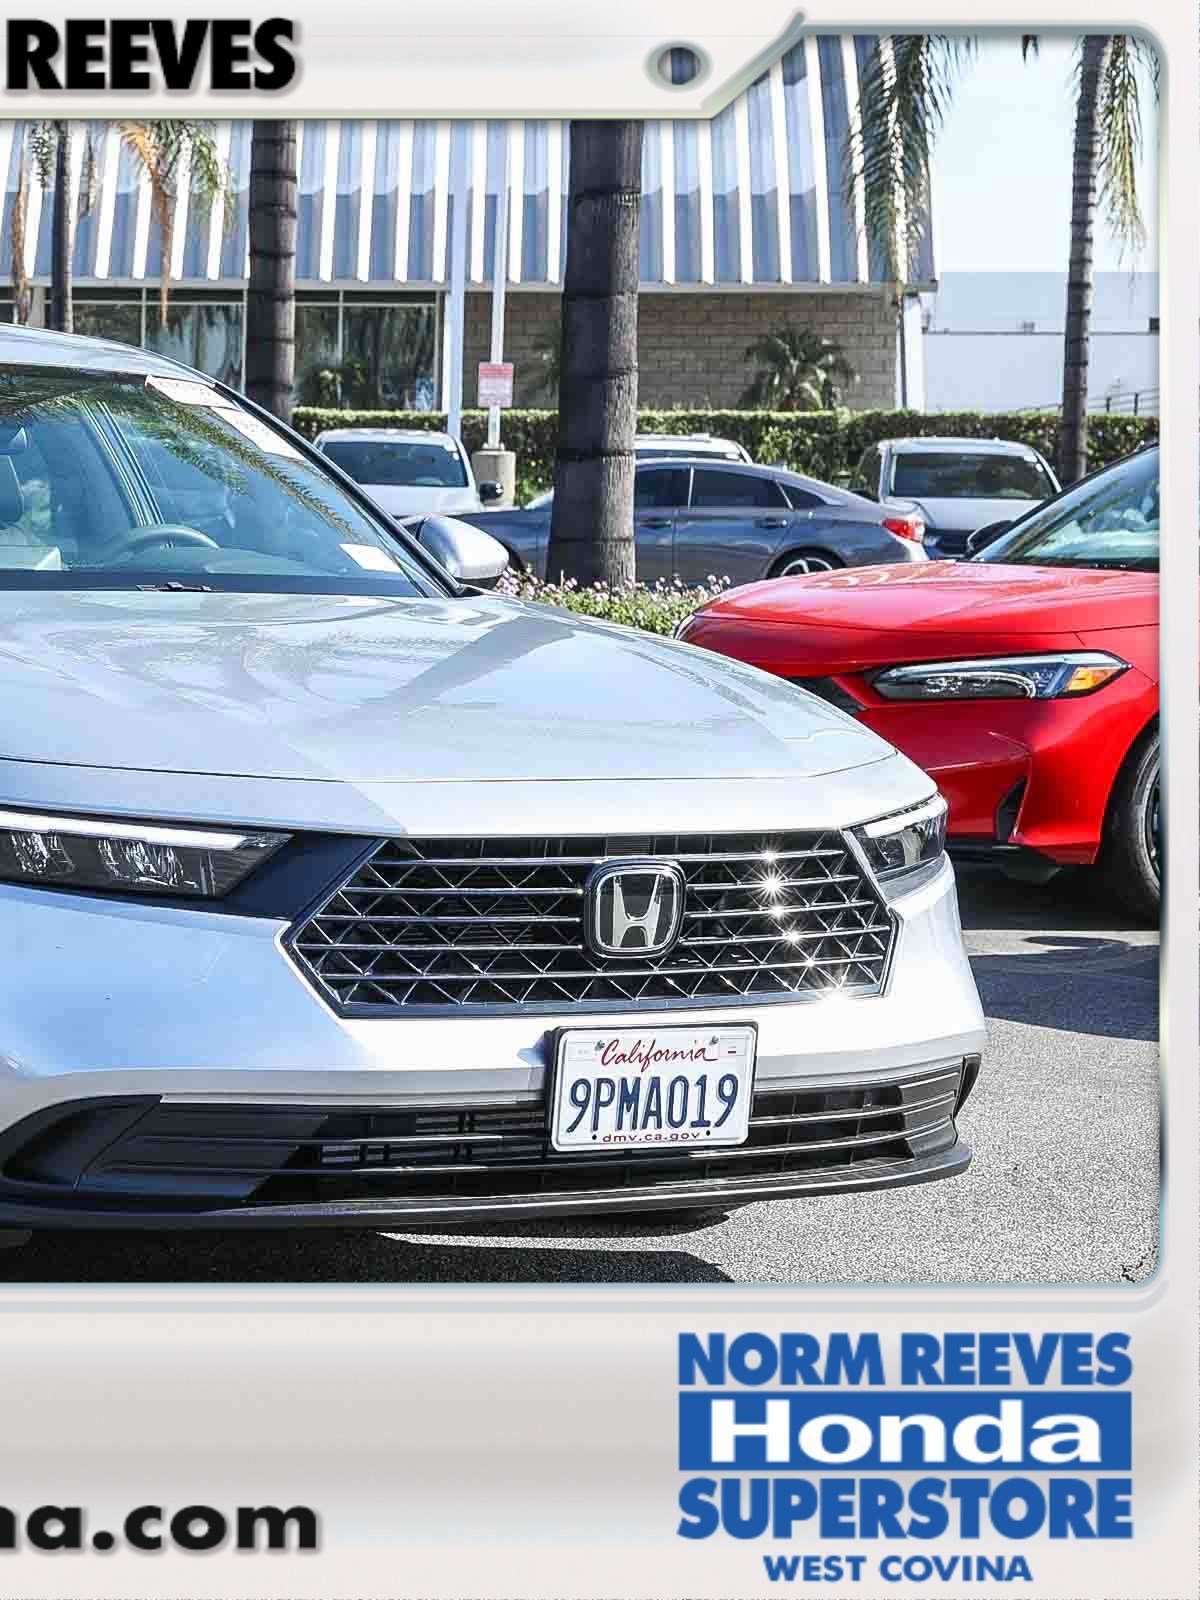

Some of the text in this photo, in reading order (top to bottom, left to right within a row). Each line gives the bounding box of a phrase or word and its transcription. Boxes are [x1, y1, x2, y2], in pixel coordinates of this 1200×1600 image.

[601, 1038, 719, 1072] California
[566, 1073, 739, 1133] 9PMA019
[602, 1131, 701, 1143] dmv.ca.gov
